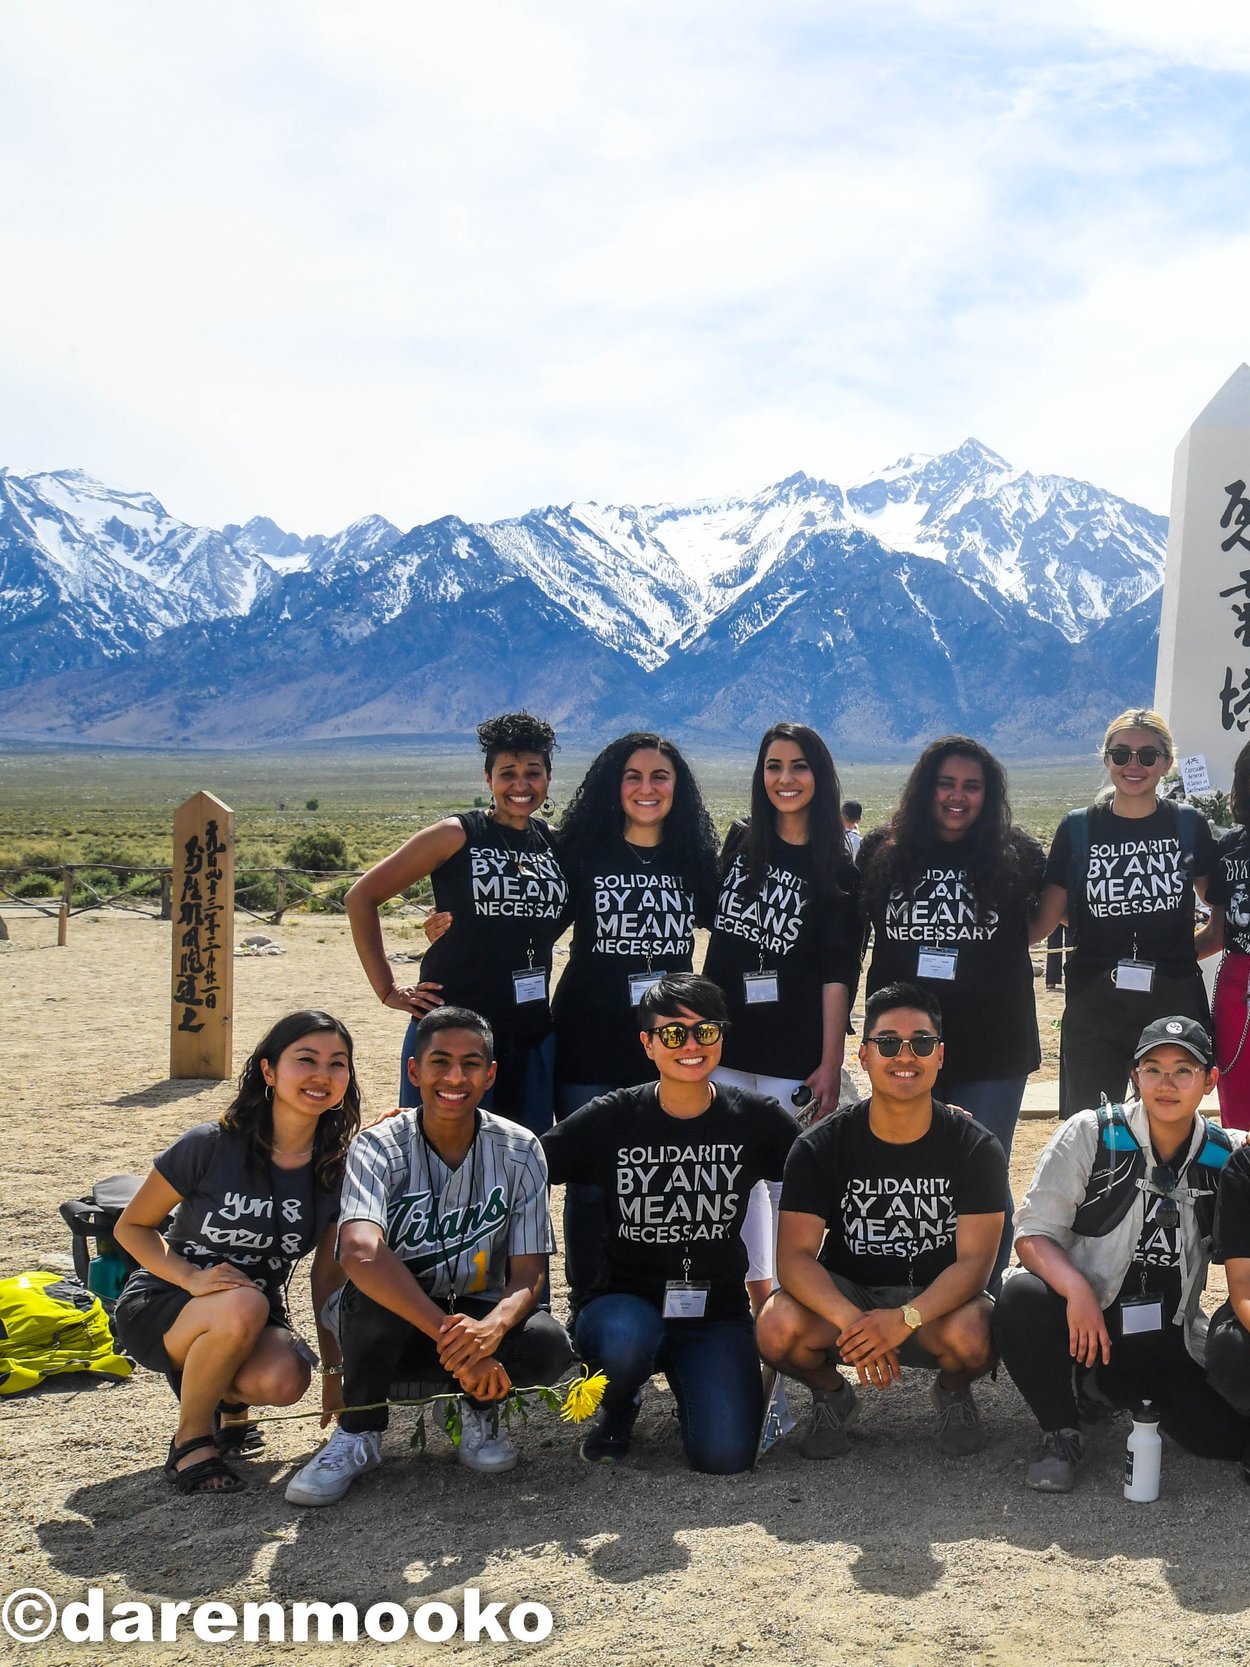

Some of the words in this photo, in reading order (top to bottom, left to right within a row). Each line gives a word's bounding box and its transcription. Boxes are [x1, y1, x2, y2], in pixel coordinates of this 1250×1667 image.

[1090, 838, 1180, 858] SOLIDARITY
[472, 858, 507, 876] BY
[1087, 858, 1120, 879] BY
[1123, 850, 1182, 877] ANY
[472, 876, 570, 903] MEAN
[1086, 871, 1184, 902] MEANS
[595, 890, 632, 912] BY
[637, 890, 695, 912] ANY
[1088, 895, 1182, 918] NECESSARY
[596, 913, 696, 937] MEANS
[886, 926, 998, 940] NECESSARY
[617, 1144, 744, 1166] SOLIDARITY
[616, 1166, 659, 1195] BY
[663, 1164, 743, 1193] ANY
[281, 1198, 302, 1223] &
[387, 1185, 508, 1254] Titans
[618, 1193, 740, 1224] MEANS
[280, 1233, 302, 1254] &
[618, 1222, 732, 1243] NECESSARY
